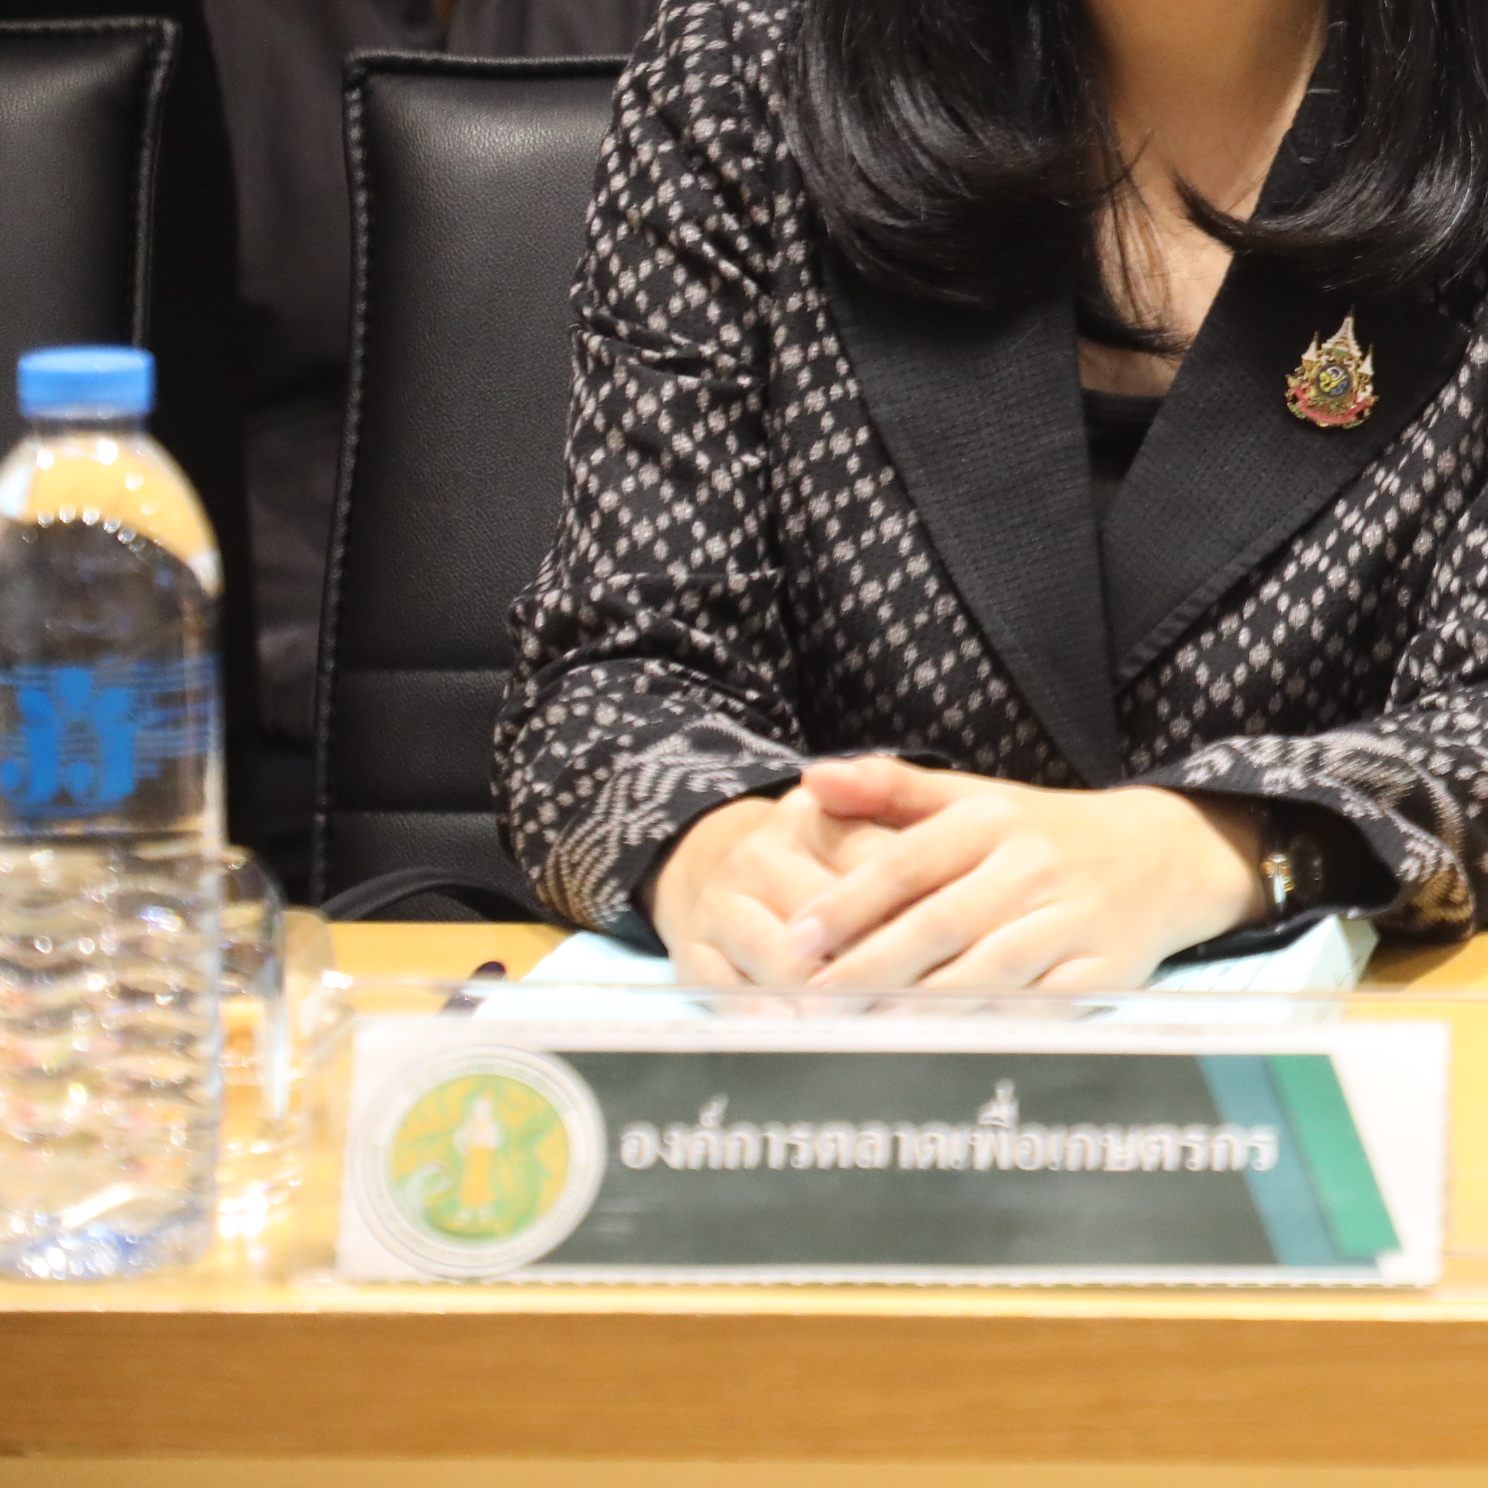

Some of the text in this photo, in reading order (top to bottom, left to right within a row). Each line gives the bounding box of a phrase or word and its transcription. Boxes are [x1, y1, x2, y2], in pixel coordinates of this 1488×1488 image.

[620, 1078, 1280, 1172] องค์การตลาดเพื่อเกษตรกร
